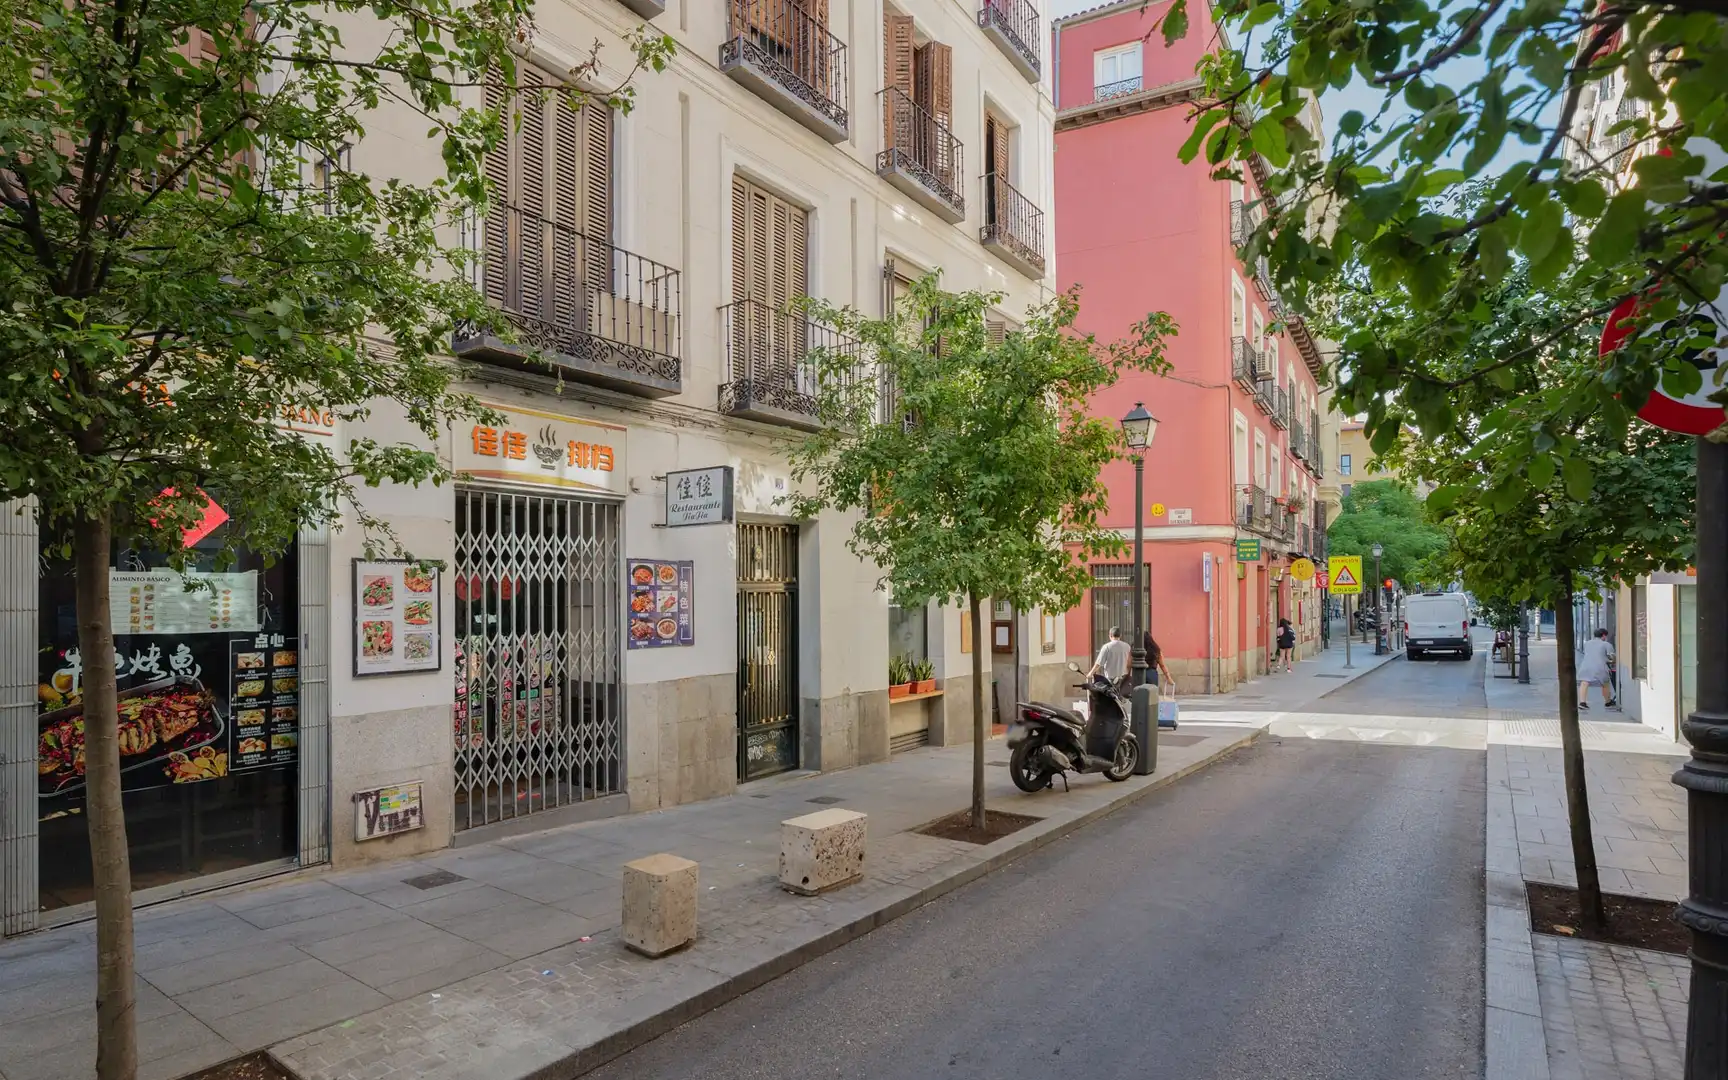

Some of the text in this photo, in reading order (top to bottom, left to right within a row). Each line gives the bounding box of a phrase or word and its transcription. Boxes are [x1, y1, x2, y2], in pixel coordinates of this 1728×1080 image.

[472, 425, 615, 472] 佳佳 排档
[255, 633, 284, 649] 点心
